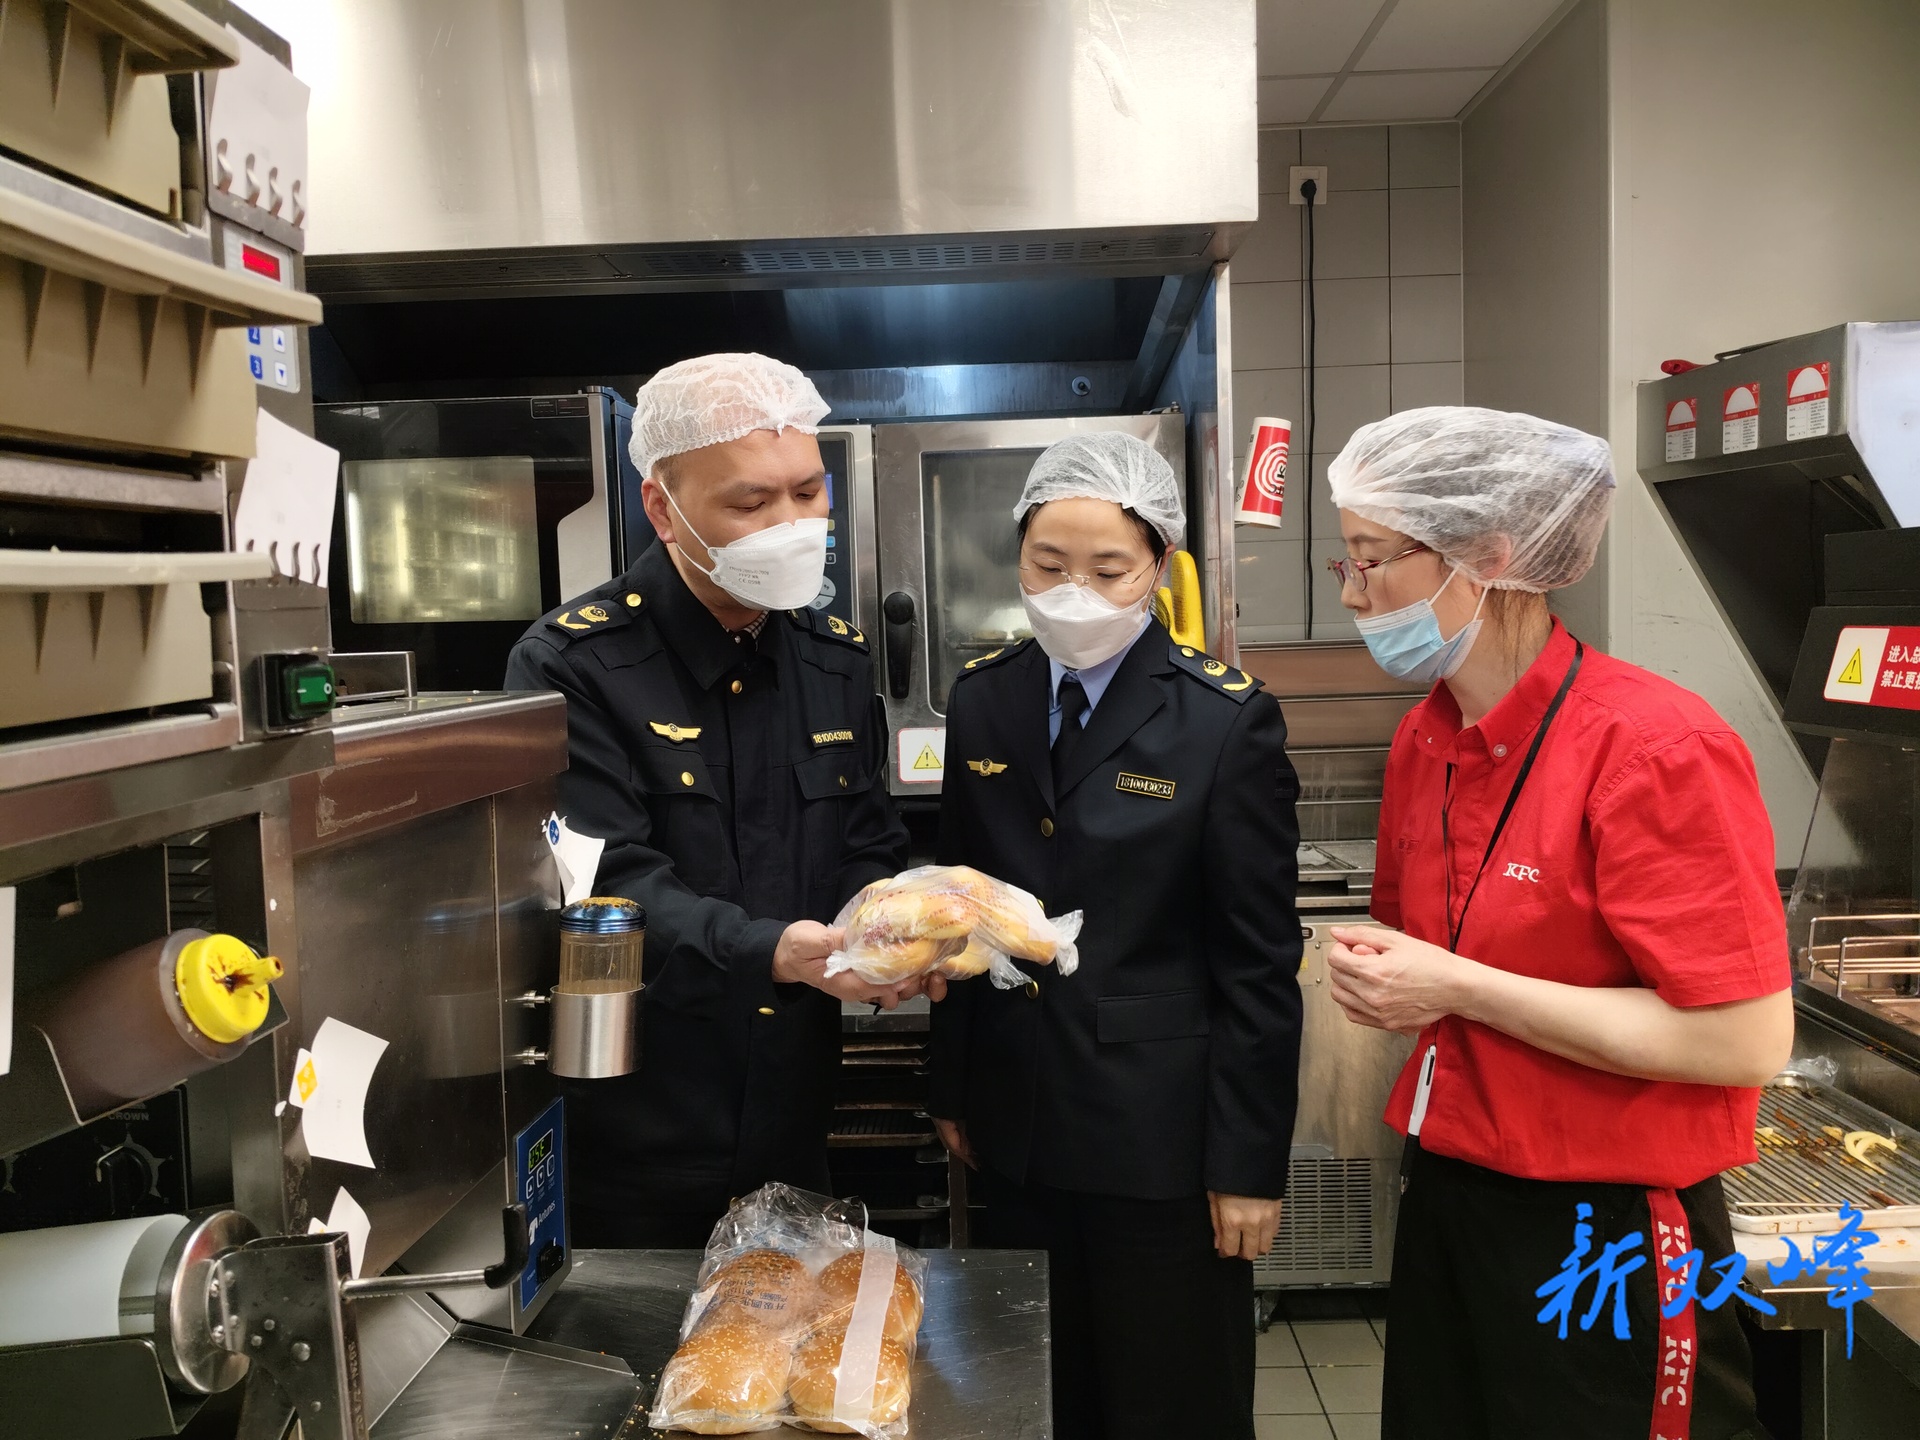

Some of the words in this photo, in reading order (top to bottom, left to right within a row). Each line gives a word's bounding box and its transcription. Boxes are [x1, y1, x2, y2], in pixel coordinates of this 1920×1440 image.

[1886, 645, 1920, 664] 进入总
[1120, 776, 1171, 796] 18100430233
[1502, 862, 1540, 883] KFC
[108, 1111, 150, 1121] CROWN
[1661, 1335, 1692, 1406] KFC
